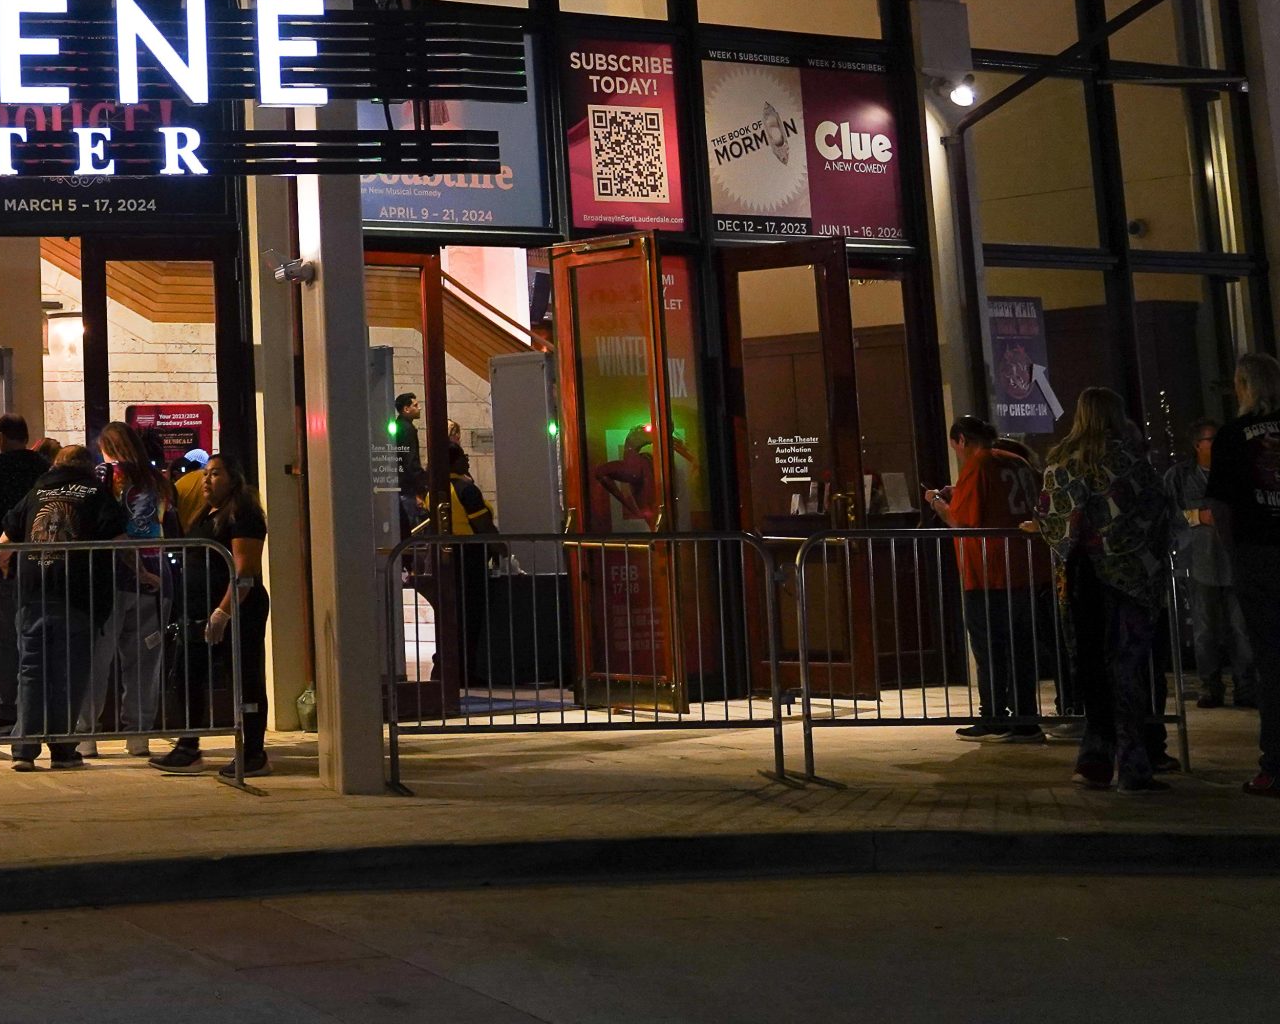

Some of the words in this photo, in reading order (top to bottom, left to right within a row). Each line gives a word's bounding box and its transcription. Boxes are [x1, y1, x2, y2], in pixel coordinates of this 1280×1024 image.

[570, 52, 673, 74] SUBSCRIBE
[708, 49, 731, 60] WEEK
[738, 52, 790, 64] SUBSCRIBERS
[807, 58, 829, 68] WEEK
[838, 61, 887, 73] SUBSCRIBERS
[589, 75, 657, 96] TODAY!
[711, 135, 727, 147] THE
[727, 126, 751, 141] BOOK
[752, 120, 764, 131] OF
[815, 120, 893, 163] Clue
[824, 161, 831, 171] A
[832, 162, 852, 172] NEW
[853, 163, 887, 174] COMEDY
[369, 186, 384, 195] New
[386, 187, 412, 196] Musical
[413, 189, 442, 199] Comedy
[3, 199, 63, 212] MARCH
[67, 199, 77, 212] 5
[94, 199, 113, 214] 17,
[117, 199, 157, 212] 2024
[379, 207, 417, 220] APRIL
[421, 208, 429, 220] 9
[442, 209, 459, 223] 21,
[462, 209, 493, 222] 2024
[717, 219, 740, 232] DEC
[743, 220, 755, 233] 12
[764, 221, 777, 235] 17,
[780, 222, 807, 235] 2023
[818, 224, 837, 237] JUN
[839, 225, 849, 237] 11
[877, 227, 903, 239] 2024
[664, 299, 683, 310] LET
[370, 443, 385, 451] Rene
[767, 436, 793, 445] Au-Rene
[794, 435, 819, 443] Theater
[775, 446, 811, 454] AutoNation
[775, 456, 786, 464] Box
[807, 455, 814, 463] &
[781, 466, 794, 474] Will
[610, 565, 639, 581] FEB
